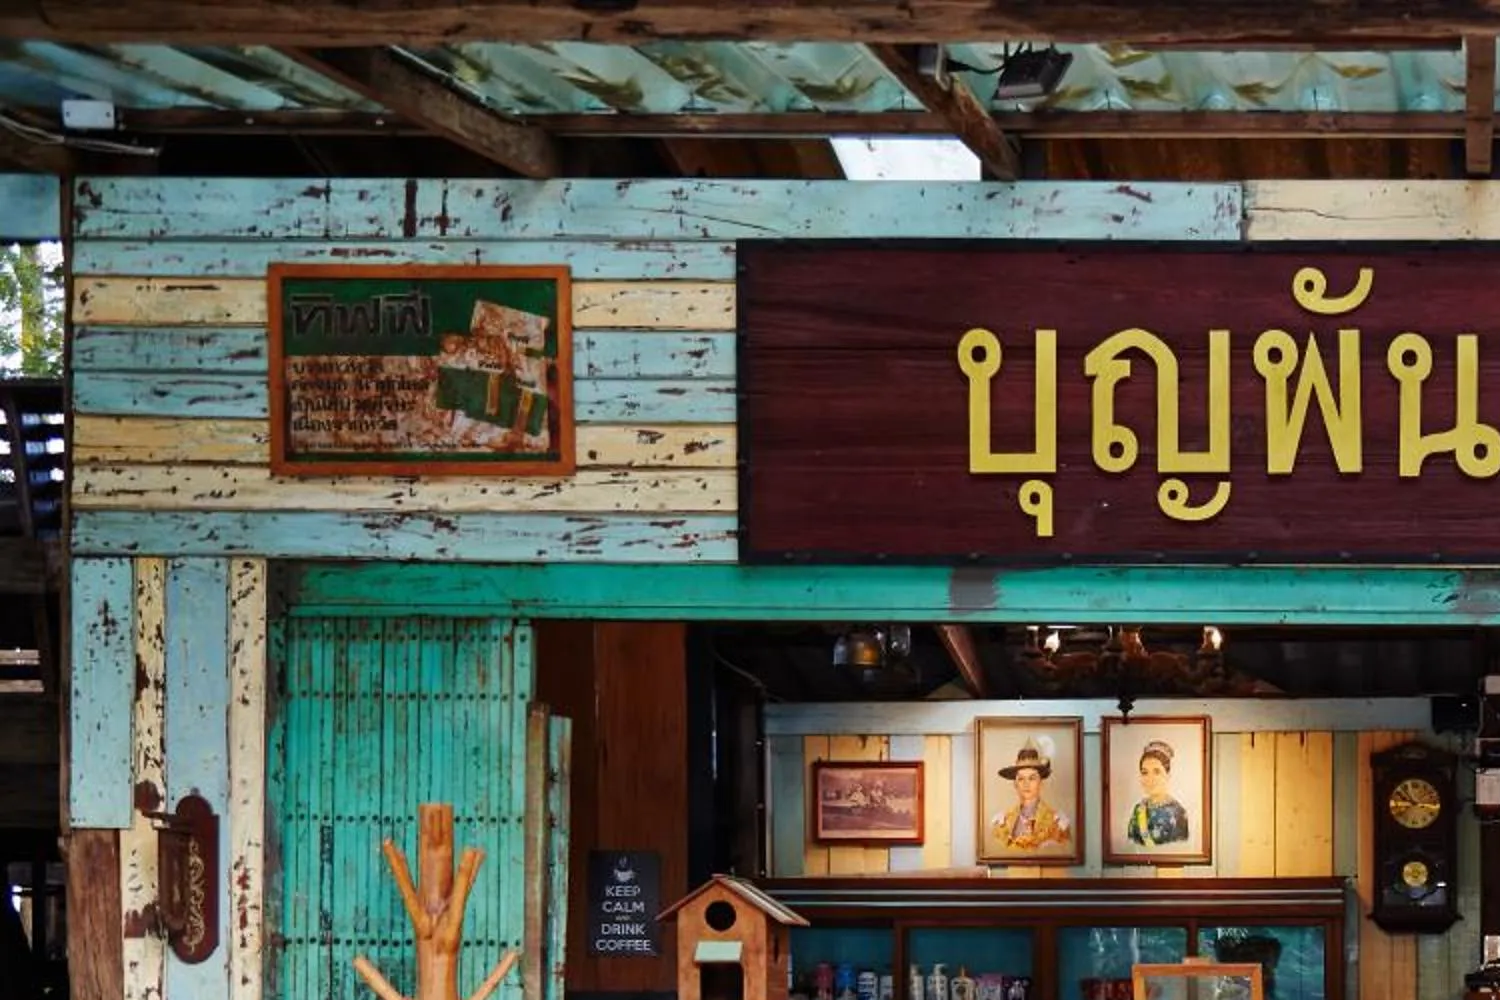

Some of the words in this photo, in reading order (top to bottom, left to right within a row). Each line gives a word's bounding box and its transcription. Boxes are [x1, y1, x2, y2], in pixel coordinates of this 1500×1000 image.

[605, 885, 641, 897] KEEP
[602, 901, 645, 913] CALM
[601, 923, 646, 935] DRINK
[595, 939, 651, 951] COFFEE
